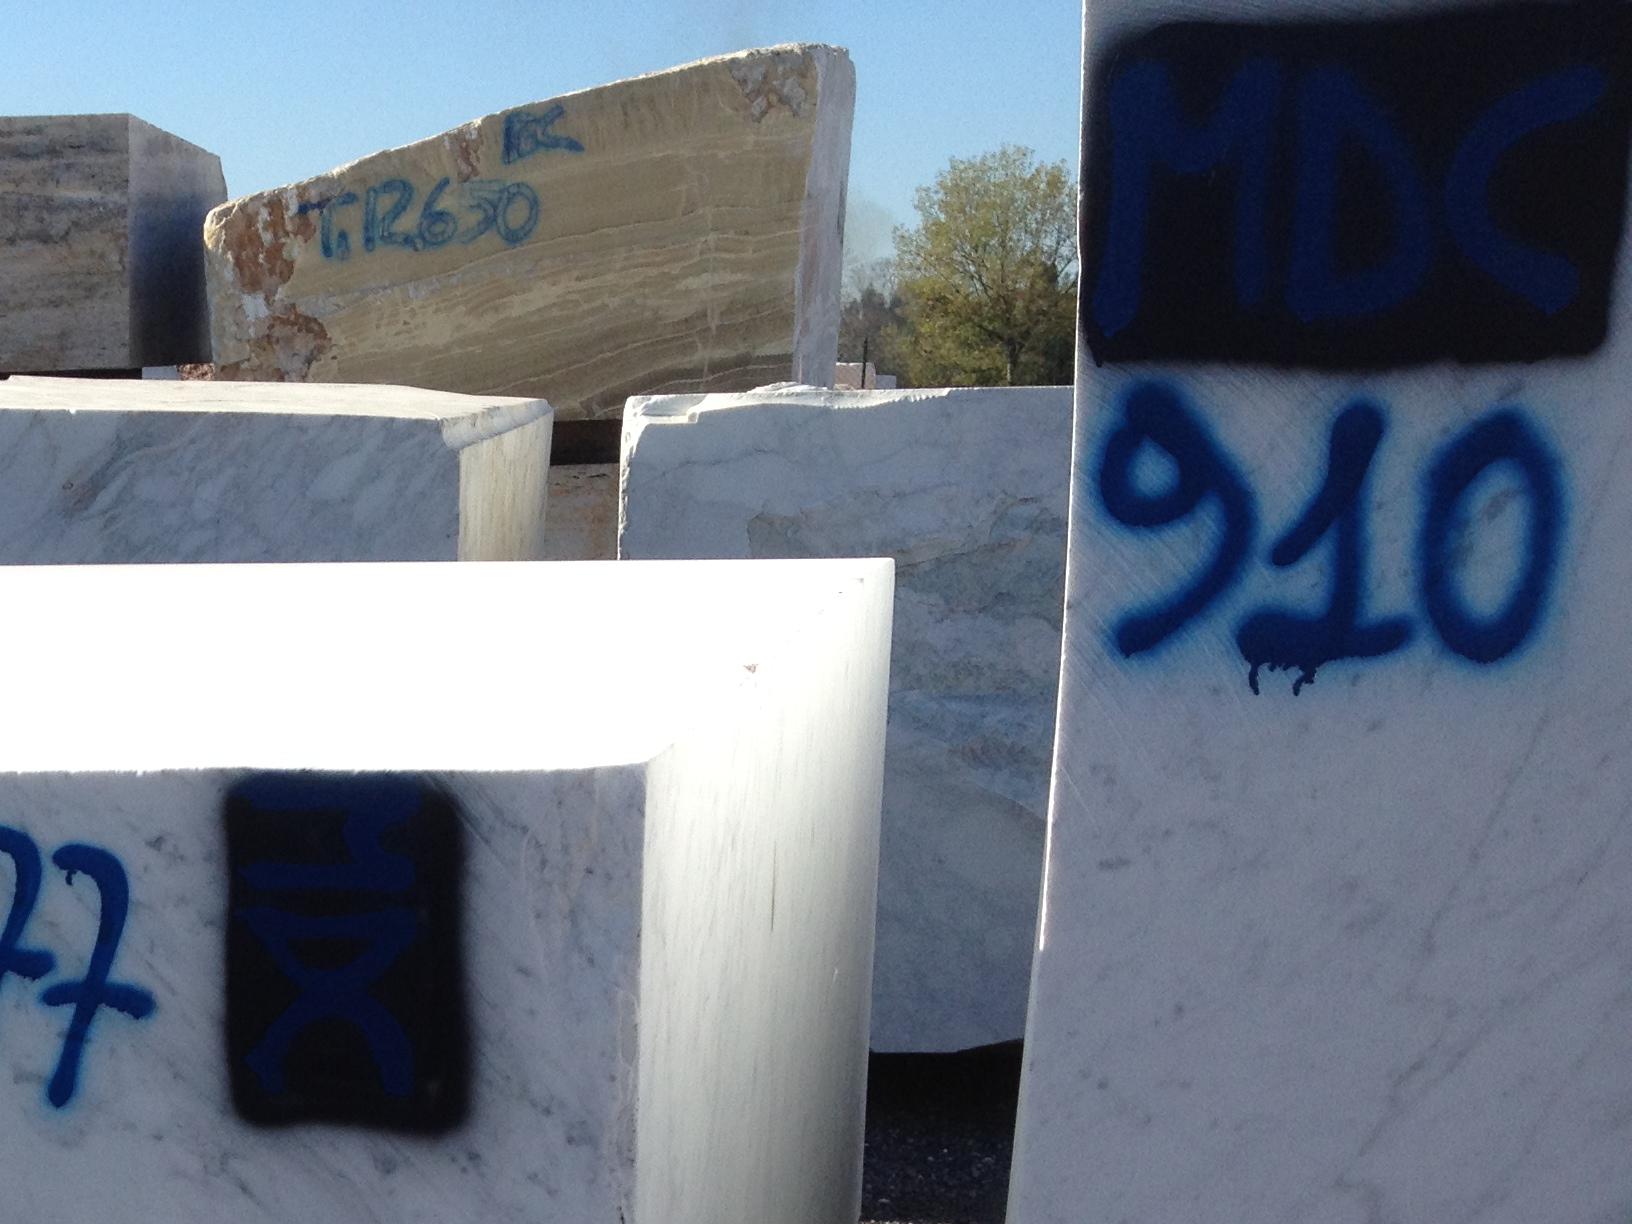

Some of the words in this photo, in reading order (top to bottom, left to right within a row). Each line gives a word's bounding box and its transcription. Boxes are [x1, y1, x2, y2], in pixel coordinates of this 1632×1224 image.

[1088, 56, 1607, 338] MDC
[1098, 381, 1567, 692] 910
[234, 770, 421, 1098] MDC
